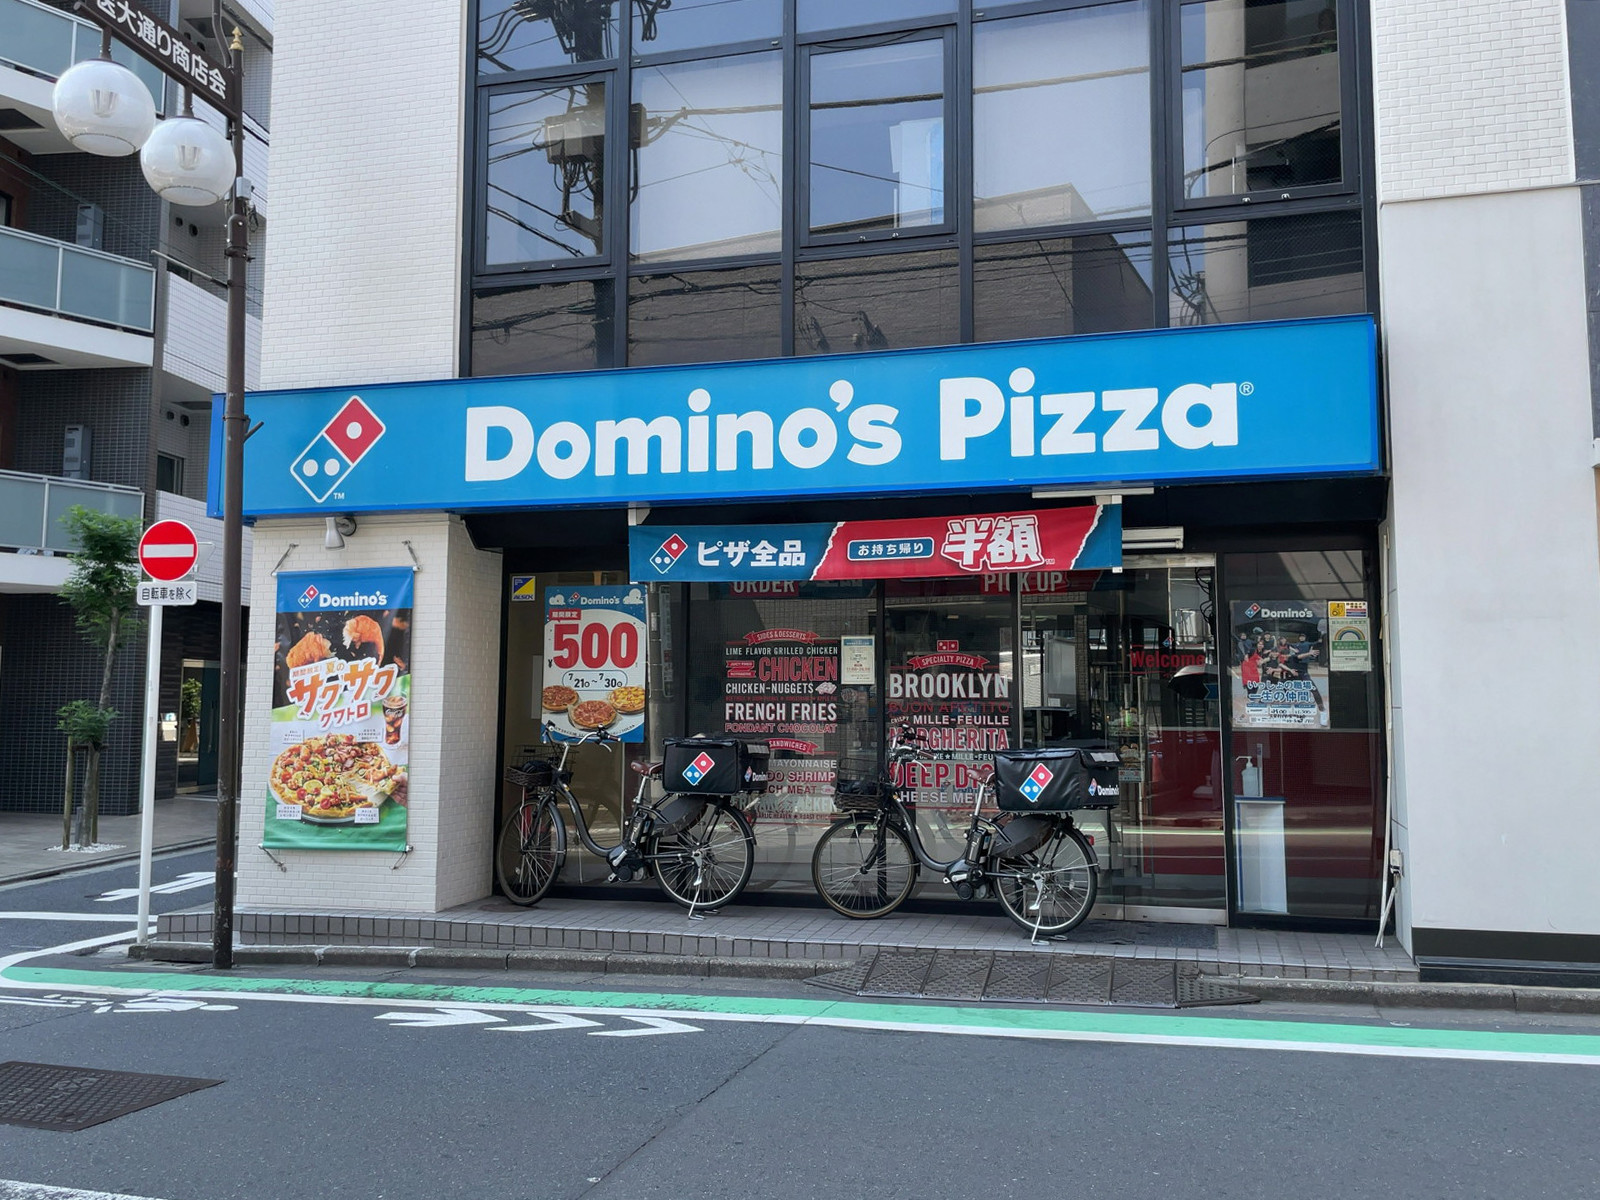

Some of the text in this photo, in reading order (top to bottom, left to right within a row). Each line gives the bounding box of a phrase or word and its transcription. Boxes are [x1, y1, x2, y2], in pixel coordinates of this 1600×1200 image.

[939, 367, 1239, 462] Pizza
[697, 540, 807, 568] ピザ全品
[857, 542, 925, 556] お持ち帰り
[942, 516, 1043, 568] 半額
[1036, 571, 1063, 593] UP
[141, 586, 192, 601] 自転車を除く
[319, 590, 388, 608] Domino's
[580, 595, 620, 606] Domino's
[1260, 607, 1314, 619] Domino's
[757, 630, 774, 641] SIDES
[778, 629, 807, 640] DESSERTS
[725, 646, 838, 656] LIME FLAVOR GRILLED CHICKEN
[921, 655, 974, 666] SPECIALTY PIZZA
[1130, 649, 1206, 668] Welcome
[758, 656, 838, 682] CHICKEN
[288, 661, 395, 715] サクサク
[725, 682, 814, 695] CHICKEN-NUGGETS
[889, 673, 1009, 698] BROOKLYN
[725, 702, 837, 721] FRENCH FRIES
[888, 701, 934, 714] BUON
[320, 703, 368, 728] クワトロ
[913, 715, 1010, 725] MILLE-FEUILLE
[725, 722, 838, 734] FONDANT CHOCOLAT
[769, 740, 807, 751] SANDWICHES
[788, 771, 836, 783] SHRIMP
[889, 762, 951, 788] DEEP
[787, 785, 817, 795] MEAT
[899, 791, 948, 804] HEESE
